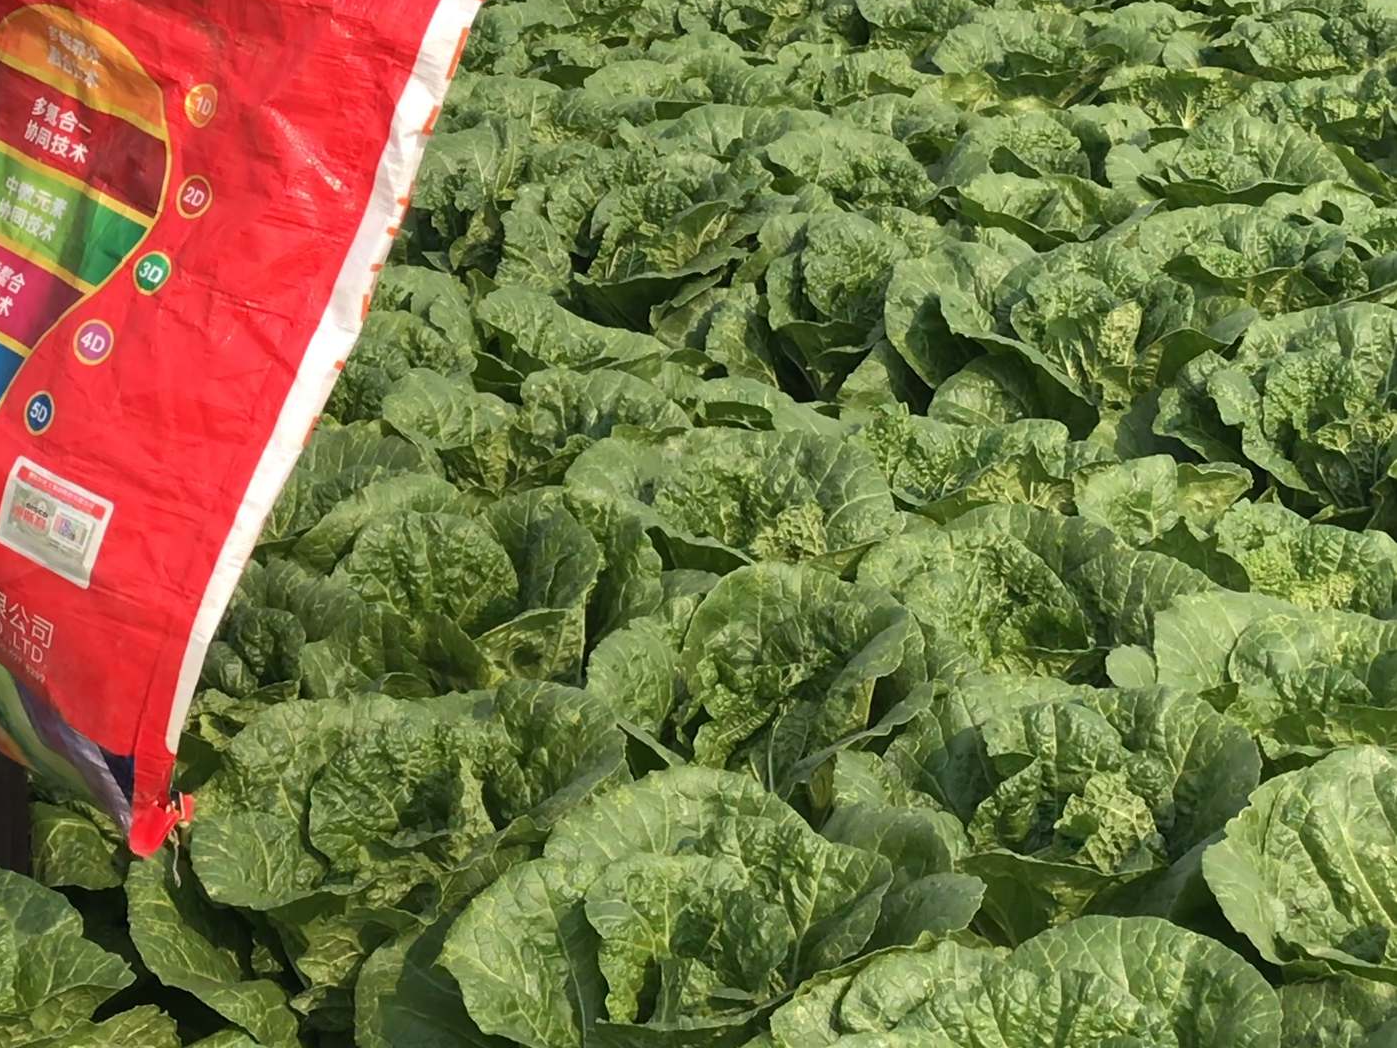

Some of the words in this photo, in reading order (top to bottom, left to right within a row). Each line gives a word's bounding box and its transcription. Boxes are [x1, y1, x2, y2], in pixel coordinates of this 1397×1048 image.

[195, 95, 212, 116] 1D
[24, 118, 89, 164] 协同技术
[182, 186, 206, 208] 2D
[138, 261, 163, 284] 3D
[80, 332, 105, 353] 4D
[30, 402, 49, 423] 5D
